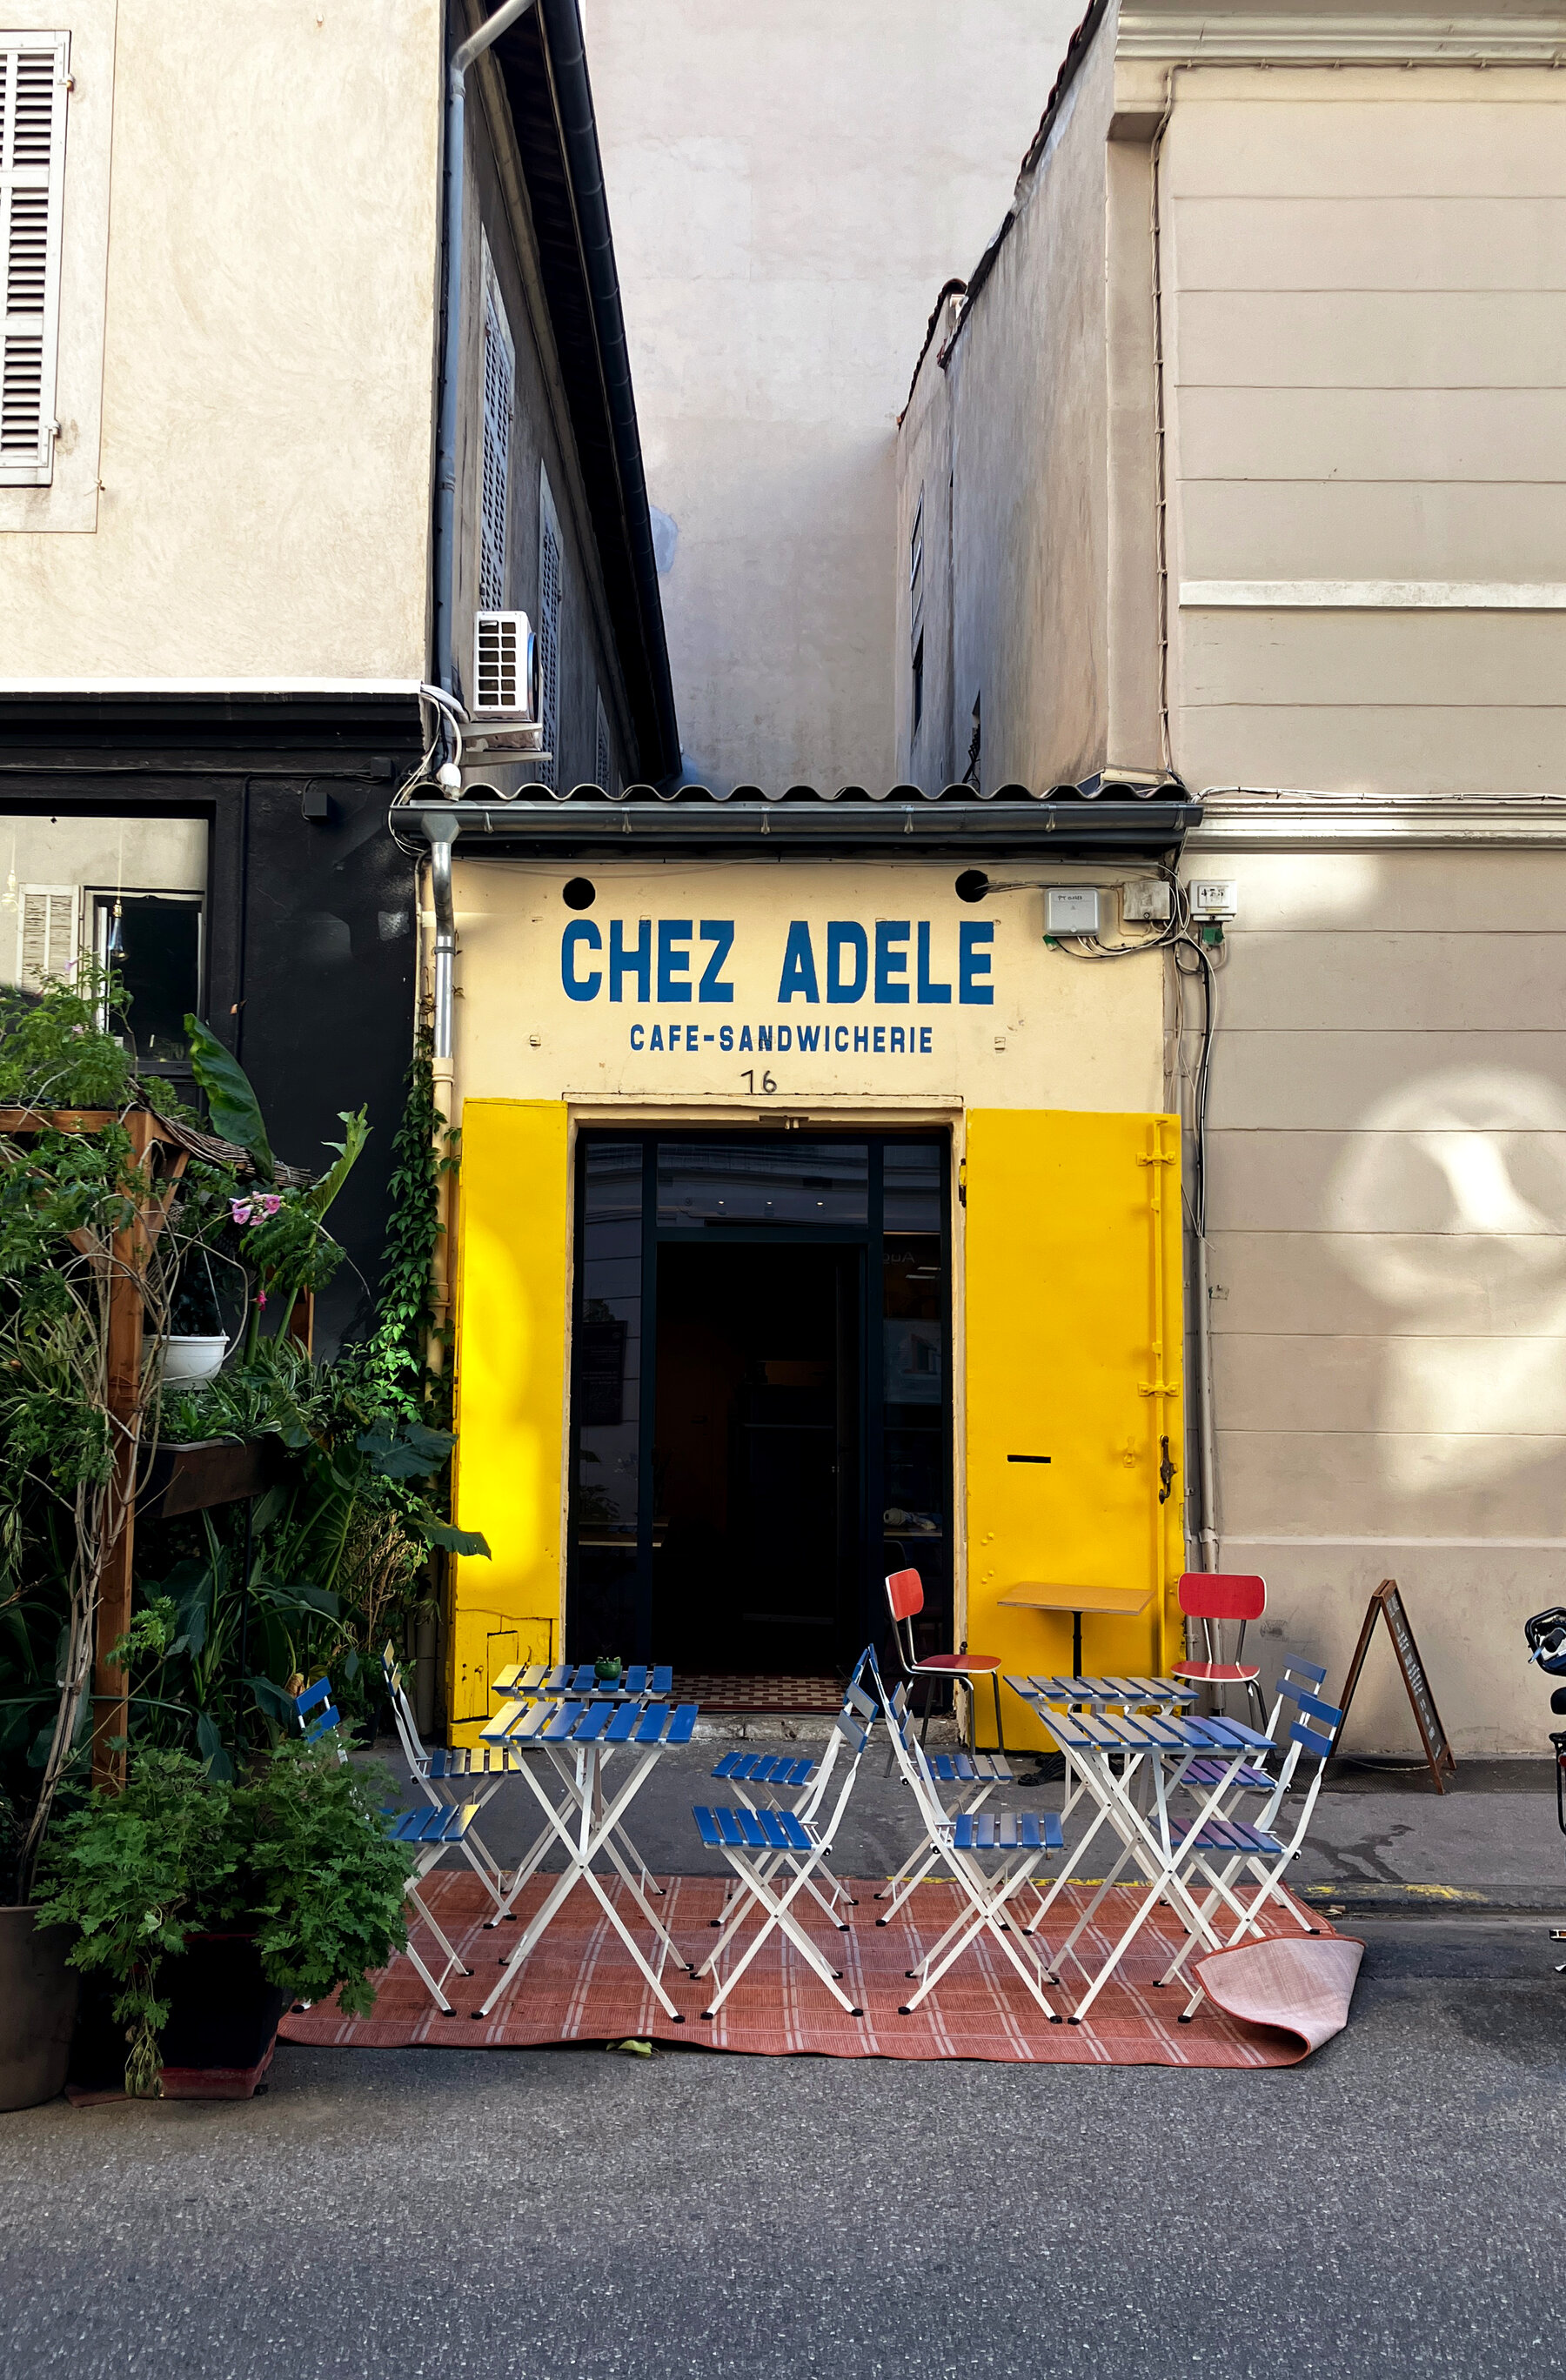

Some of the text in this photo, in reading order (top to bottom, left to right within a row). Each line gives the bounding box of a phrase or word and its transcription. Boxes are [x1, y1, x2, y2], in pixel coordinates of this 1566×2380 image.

[561, 919, 994, 1005] CHEZ ADELE
[631, 1025, 934, 1053] CAFE-SANDWICHERIE
[740, 1069, 778, 1094] 16
